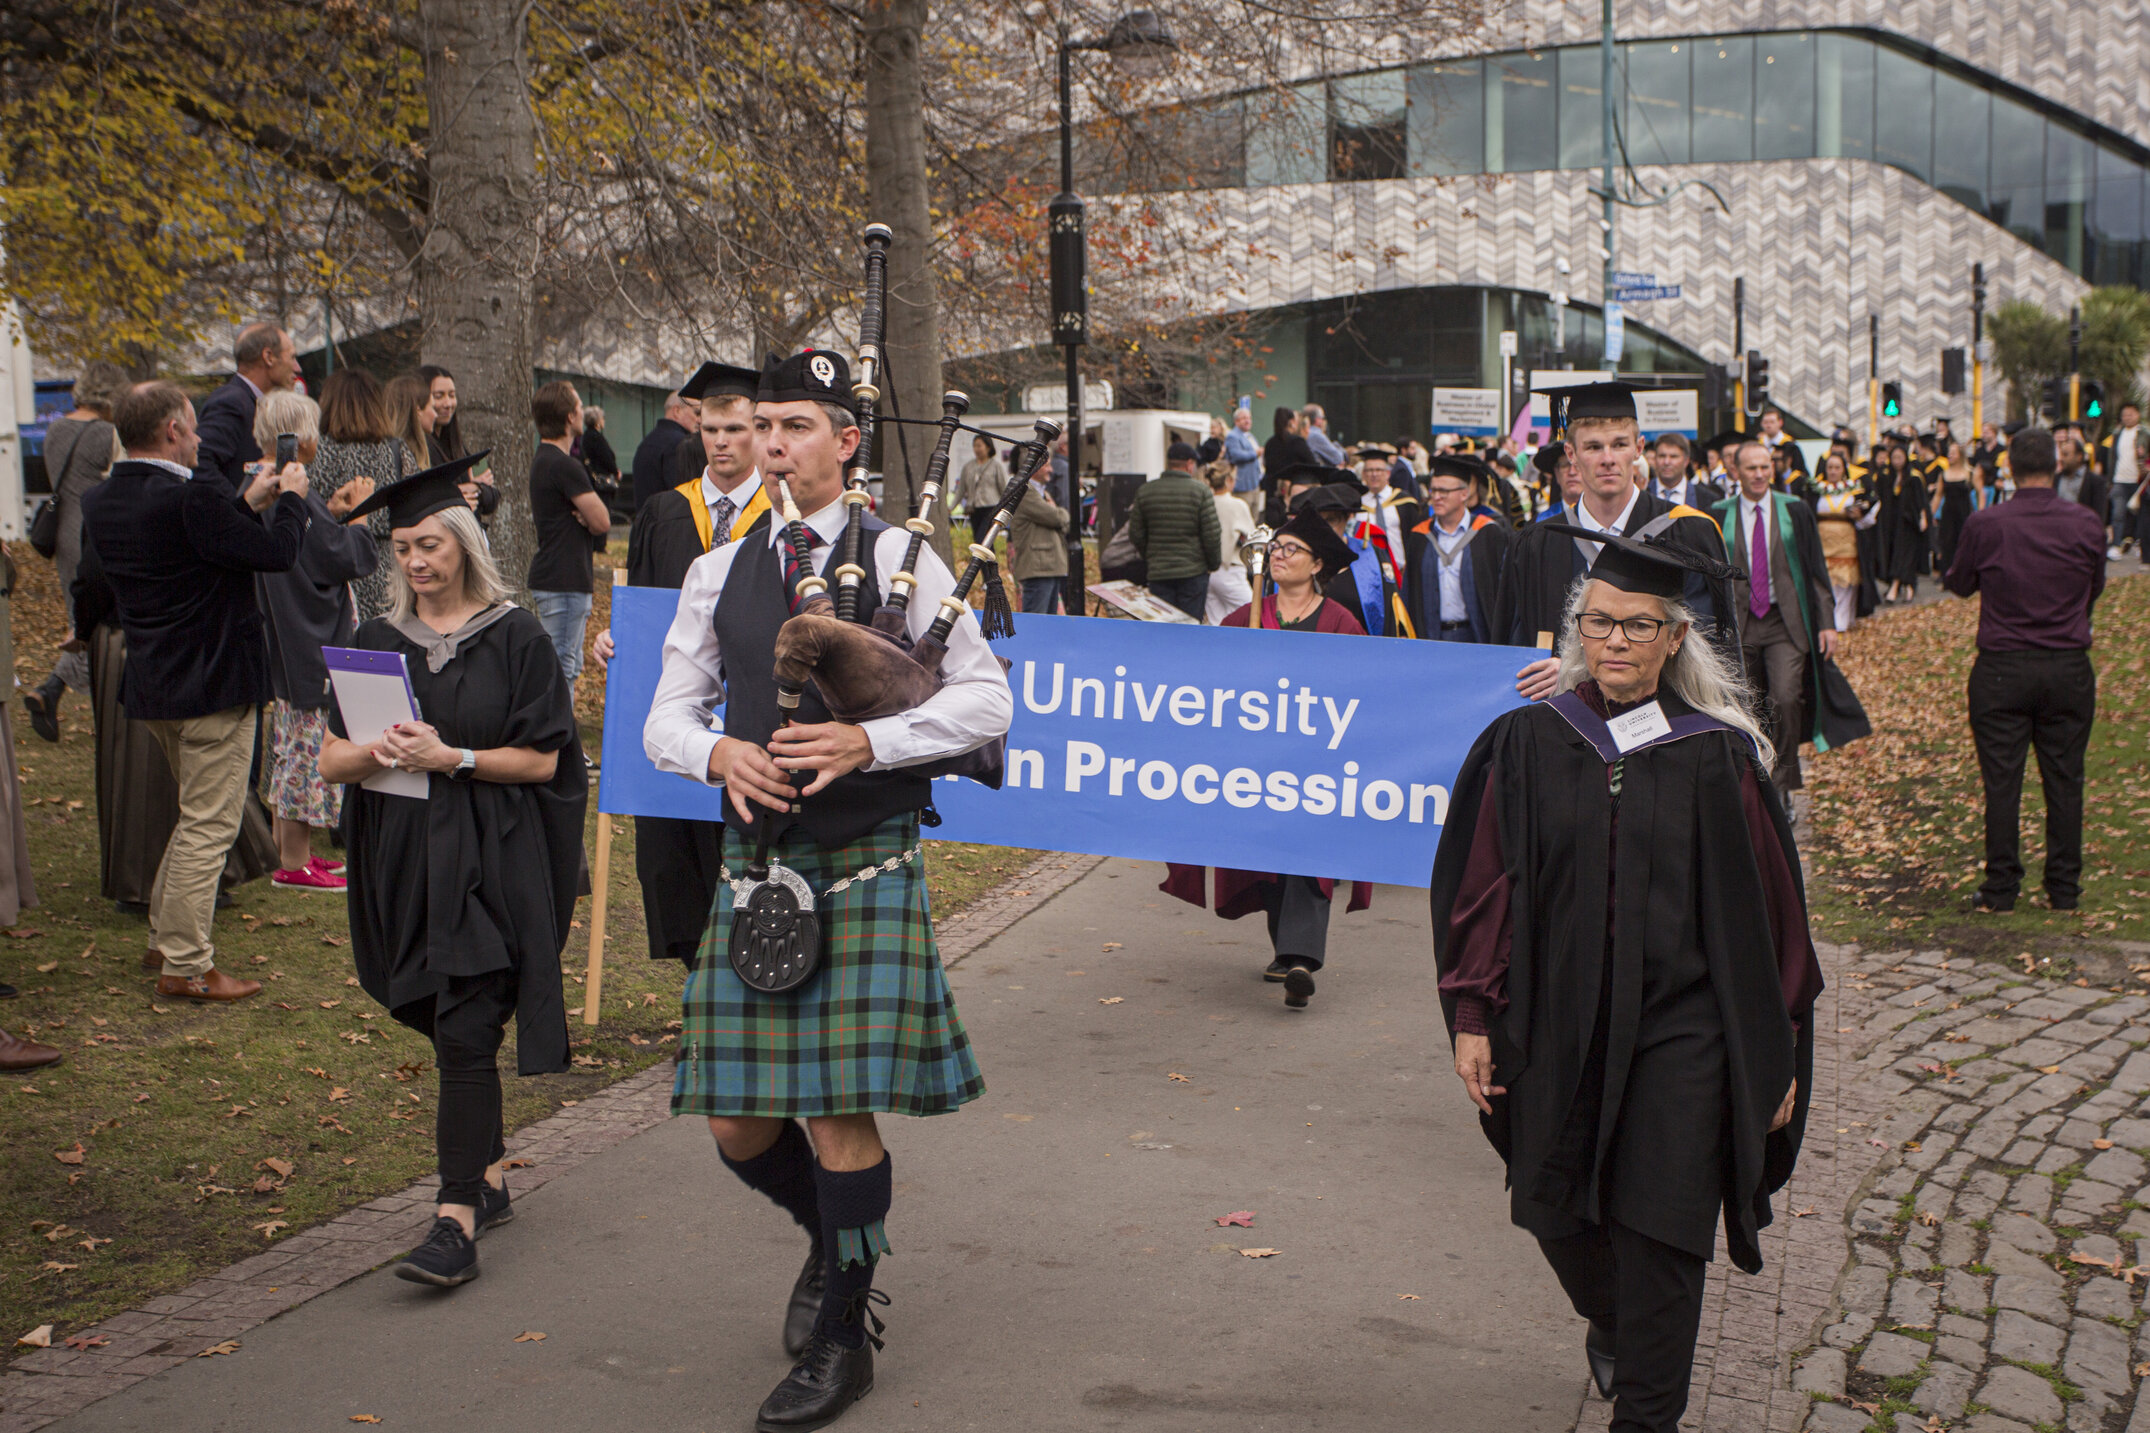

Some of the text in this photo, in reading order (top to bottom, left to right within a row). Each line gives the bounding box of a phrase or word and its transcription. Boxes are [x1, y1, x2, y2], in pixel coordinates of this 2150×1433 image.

[1618, 288, 1664, 300] Armagh
[1023, 661, 1360, 750] University
[1631, 726, 1654, 738] Marshall
[1065, 740, 1449, 826] Procession
